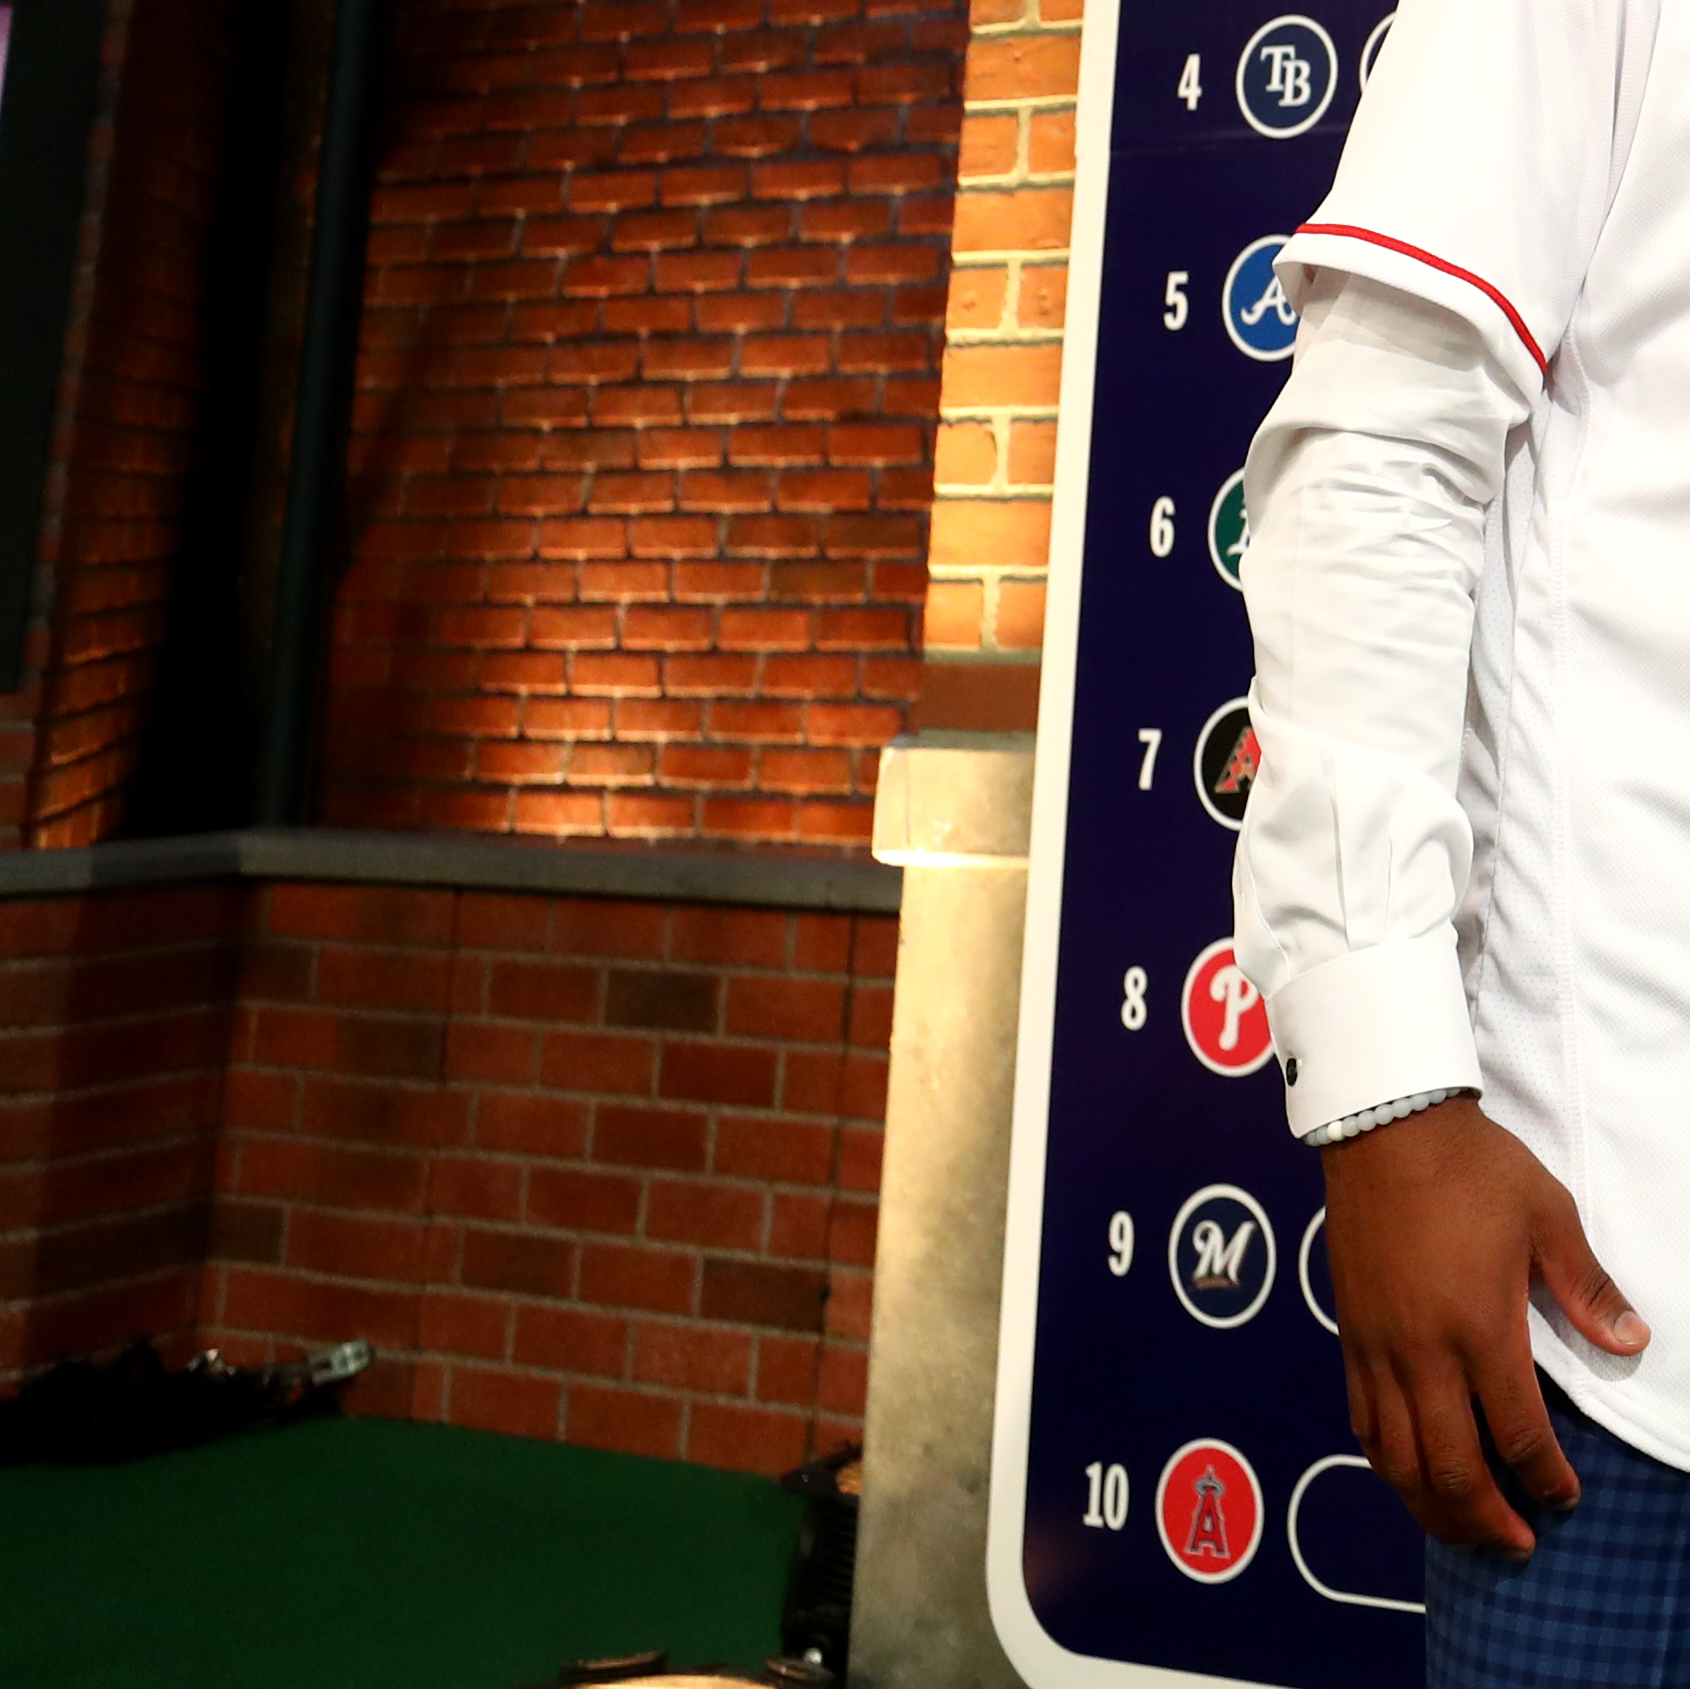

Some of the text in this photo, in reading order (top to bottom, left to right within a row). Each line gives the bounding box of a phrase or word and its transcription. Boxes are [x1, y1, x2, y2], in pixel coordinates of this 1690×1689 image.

[1178, 53, 1202, 111] 4
[1164, 271, 1188, 330] 5
[1150, 496, 1175, 557] 6
[1138, 728, 1162, 790] 7
[1121, 966, 1147, 1030] 8
[1108, 1211, 1134, 1276] 9
[1083, 1462, 1129, 1531] 10
